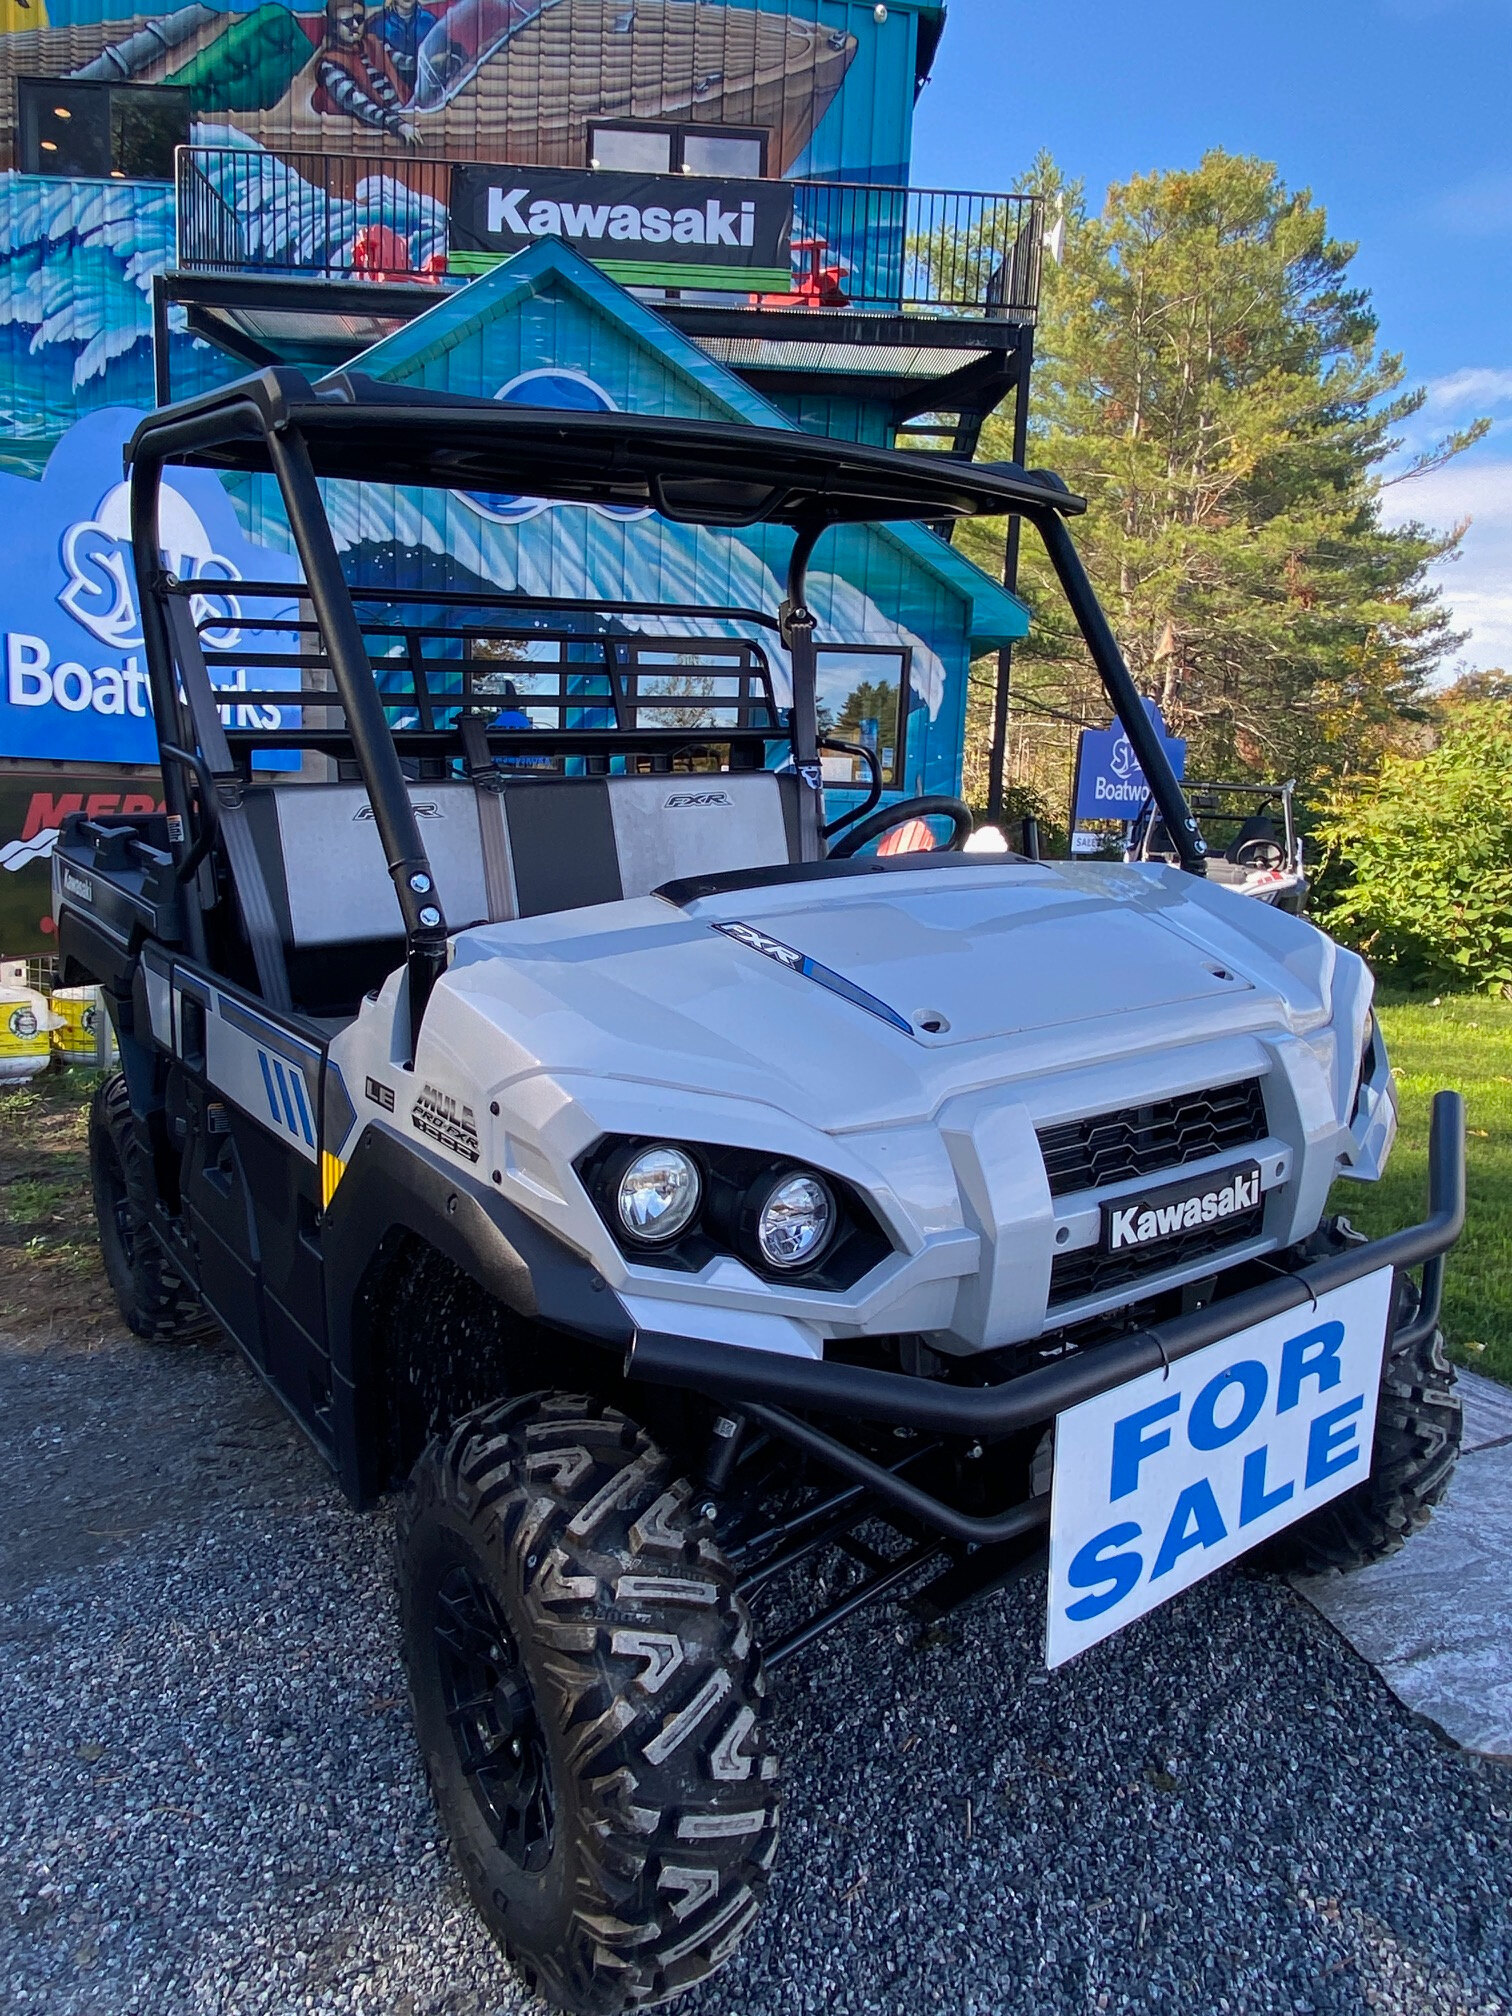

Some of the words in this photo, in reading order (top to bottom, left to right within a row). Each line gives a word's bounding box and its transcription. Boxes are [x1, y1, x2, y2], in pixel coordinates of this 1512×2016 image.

[487, 187, 755, 247] Kawasaki
[7, 632, 282, 730] Boatrks
[664, 792, 733, 808] FXR
[720, 923, 802, 970] FXR
[365, 1077, 394, 1112] LE
[416, 1084, 478, 1138] MULE
[1112, 1170, 1260, 1249] Kawasaki
[1108, 1320, 1346, 1504] FOR
[1064, 1393, 1365, 1622] SALE
